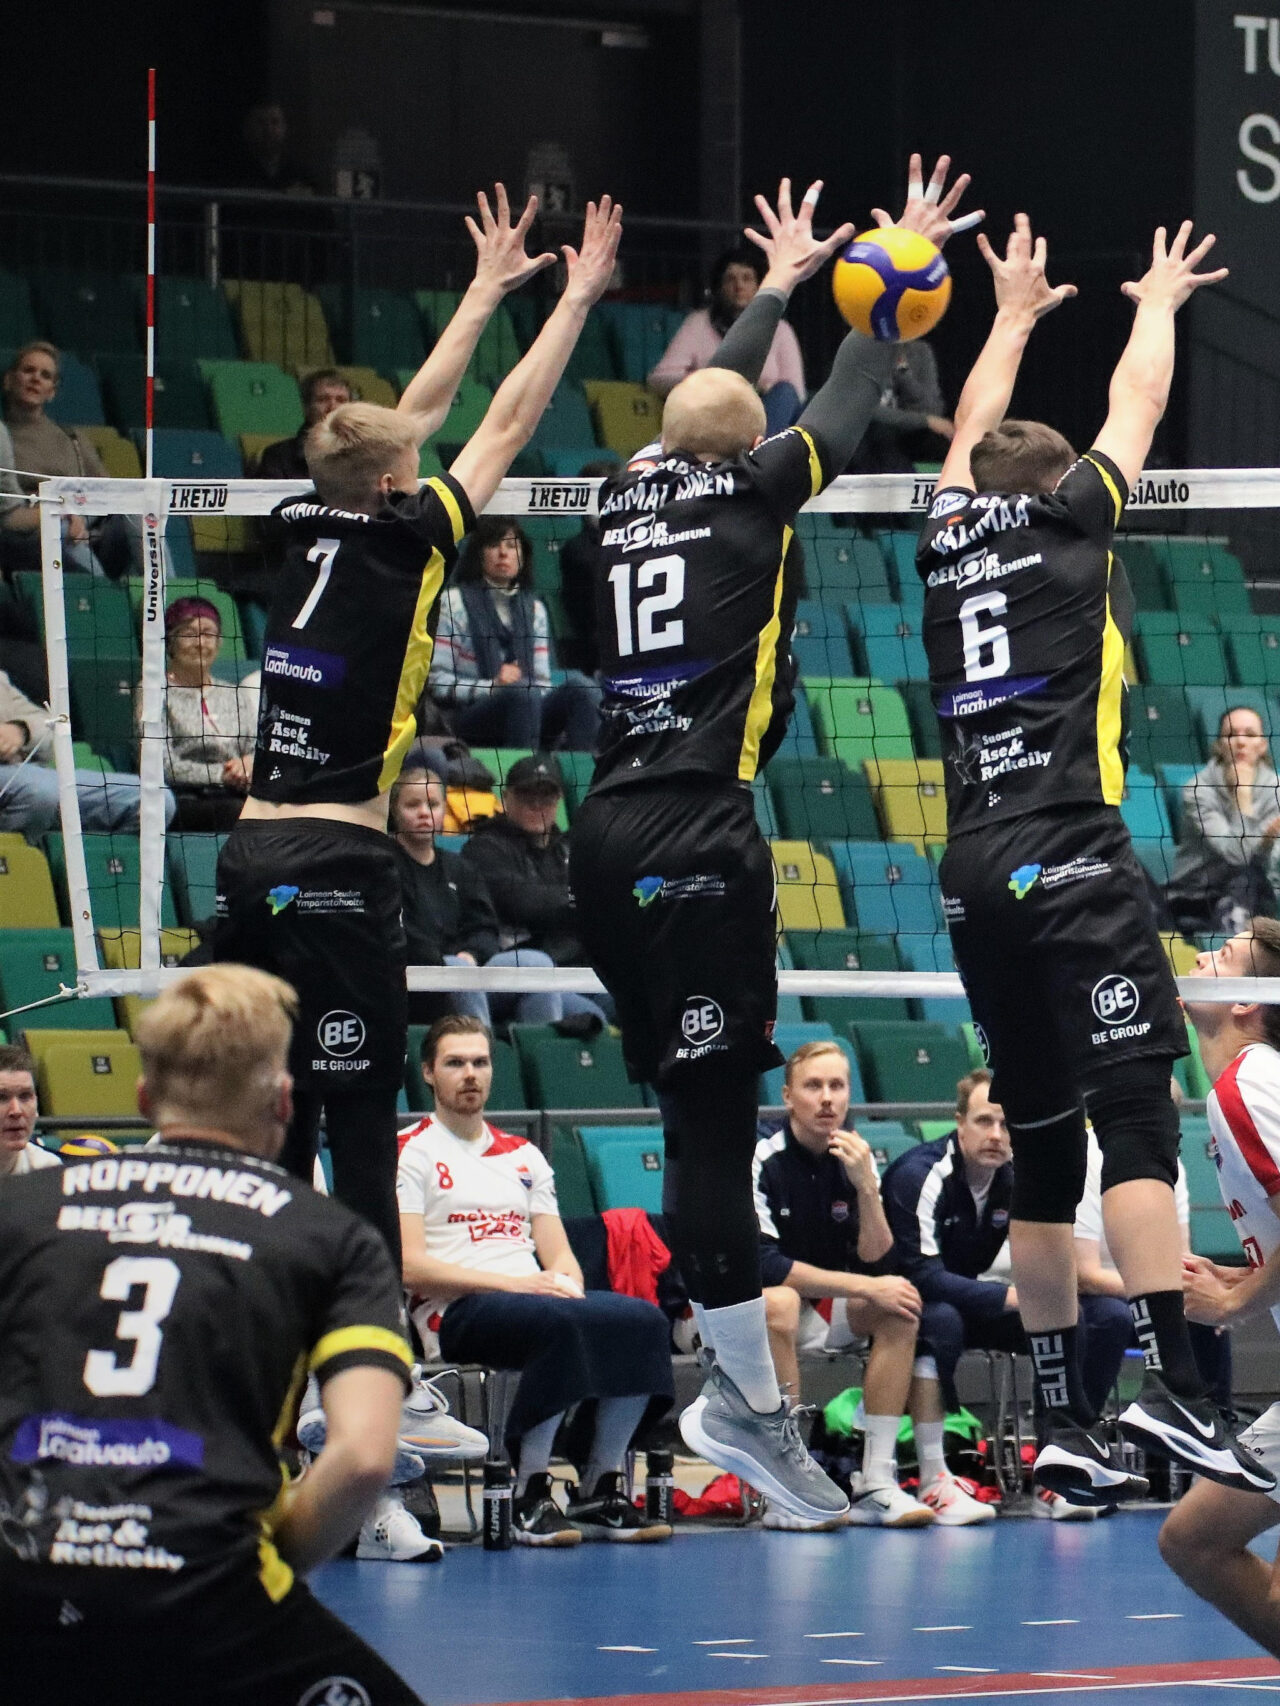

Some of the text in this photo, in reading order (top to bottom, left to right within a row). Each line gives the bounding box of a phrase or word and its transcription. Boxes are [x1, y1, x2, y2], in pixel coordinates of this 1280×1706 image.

[651, 526, 712, 549] PREMIUM
[146, 531, 160, 622] Universal
[985, 553, 1043, 582] PREMIUM
[290, 537, 342, 630] 7
[607, 554, 687, 657] 12
[958, 590, 1011, 683] 6
[264, 655, 323, 683] Laatuauto
[279, 710, 312, 727] Suomen
[981, 726, 1023, 746] Suomen
[268, 738, 331, 765] Retkeily
[980, 750, 1053, 782] Retkeily
[1097, 980, 1134, 1018] BE
[323, 1018, 360, 1047] BE
[684, 1005, 718, 1036] BE
[1092, 1022, 1152, 1046] BE GROUP
[311, 1059, 371, 1071] BE GROUP
[62, 1159, 294, 1218] ROPPONEN
[436, 1161, 454, 1190] 8
[82, 1255, 183, 1398] 3
